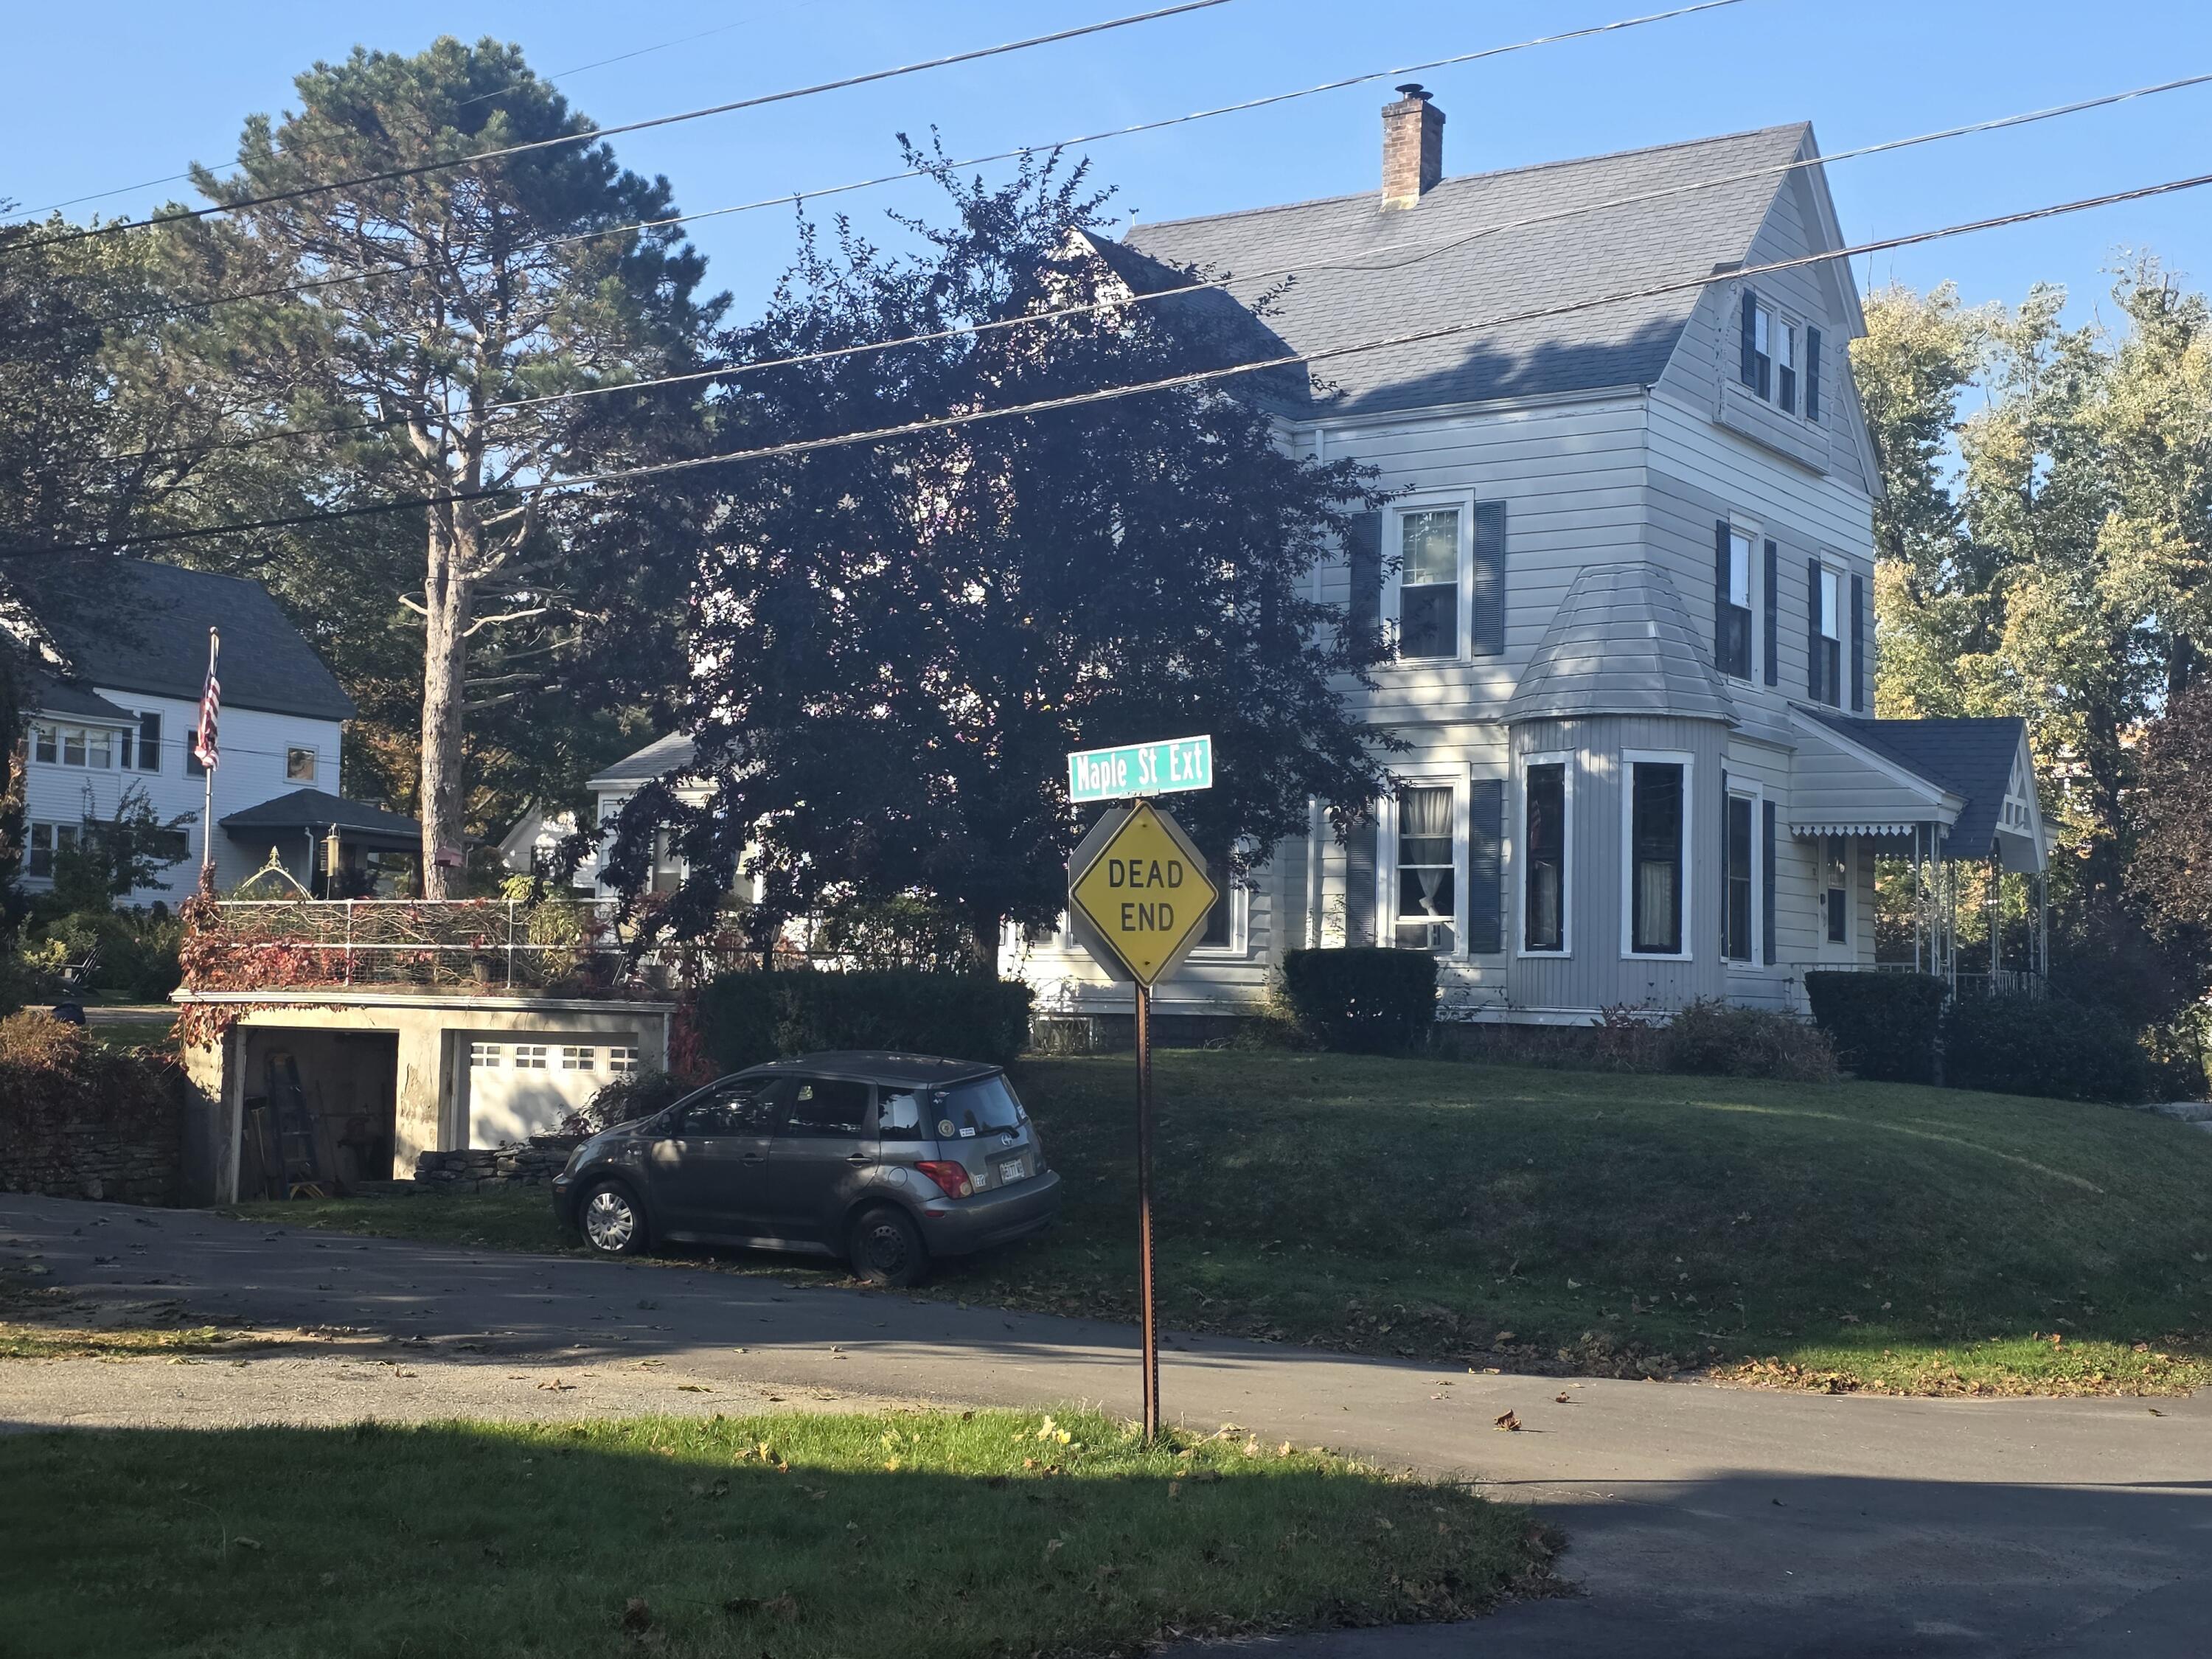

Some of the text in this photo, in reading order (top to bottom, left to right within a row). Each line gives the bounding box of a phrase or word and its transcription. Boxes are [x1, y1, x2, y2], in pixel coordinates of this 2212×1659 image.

[1077, 743, 1203, 795] Maple St Ext
[1109, 860, 1183, 888] DEAD
[1121, 903, 1174, 931] END
